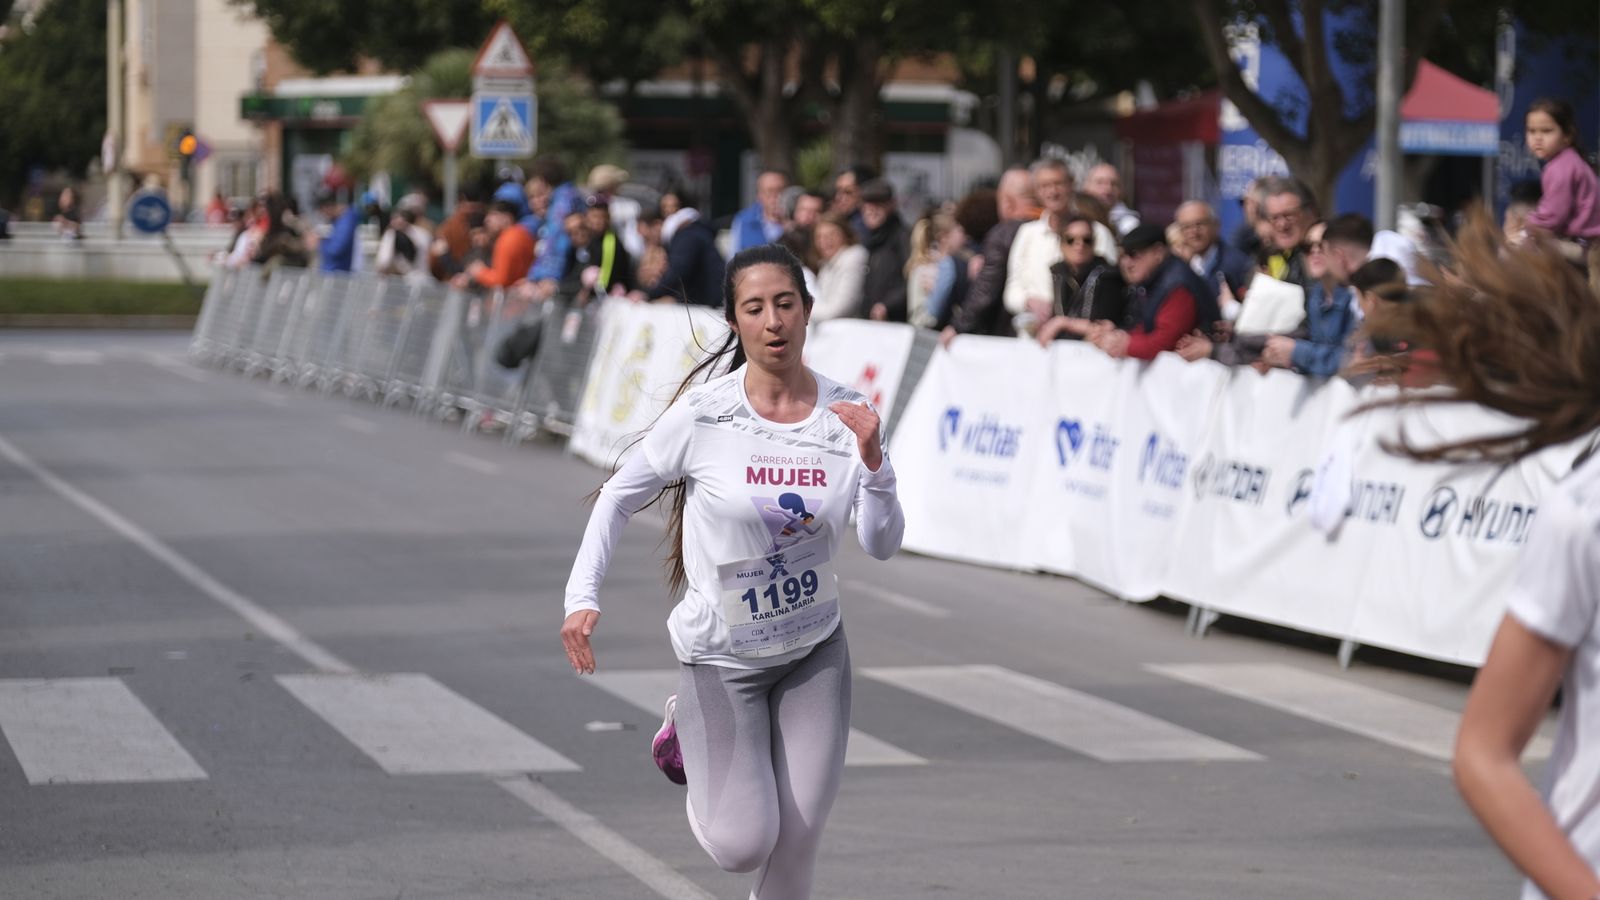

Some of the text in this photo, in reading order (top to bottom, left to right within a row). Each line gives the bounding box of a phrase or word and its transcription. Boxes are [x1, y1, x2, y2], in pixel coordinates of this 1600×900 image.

[750, 454, 823, 465] CARRERA DE LA
[746, 466, 827, 487] MUJER
[1457, 496, 1538, 543] HYUND
[736, 569, 764, 579] MUJER
[741, 569, 819, 613] 1199
[751, 606, 791, 621] KARLINA
[791, 595, 815, 612] MARIA
